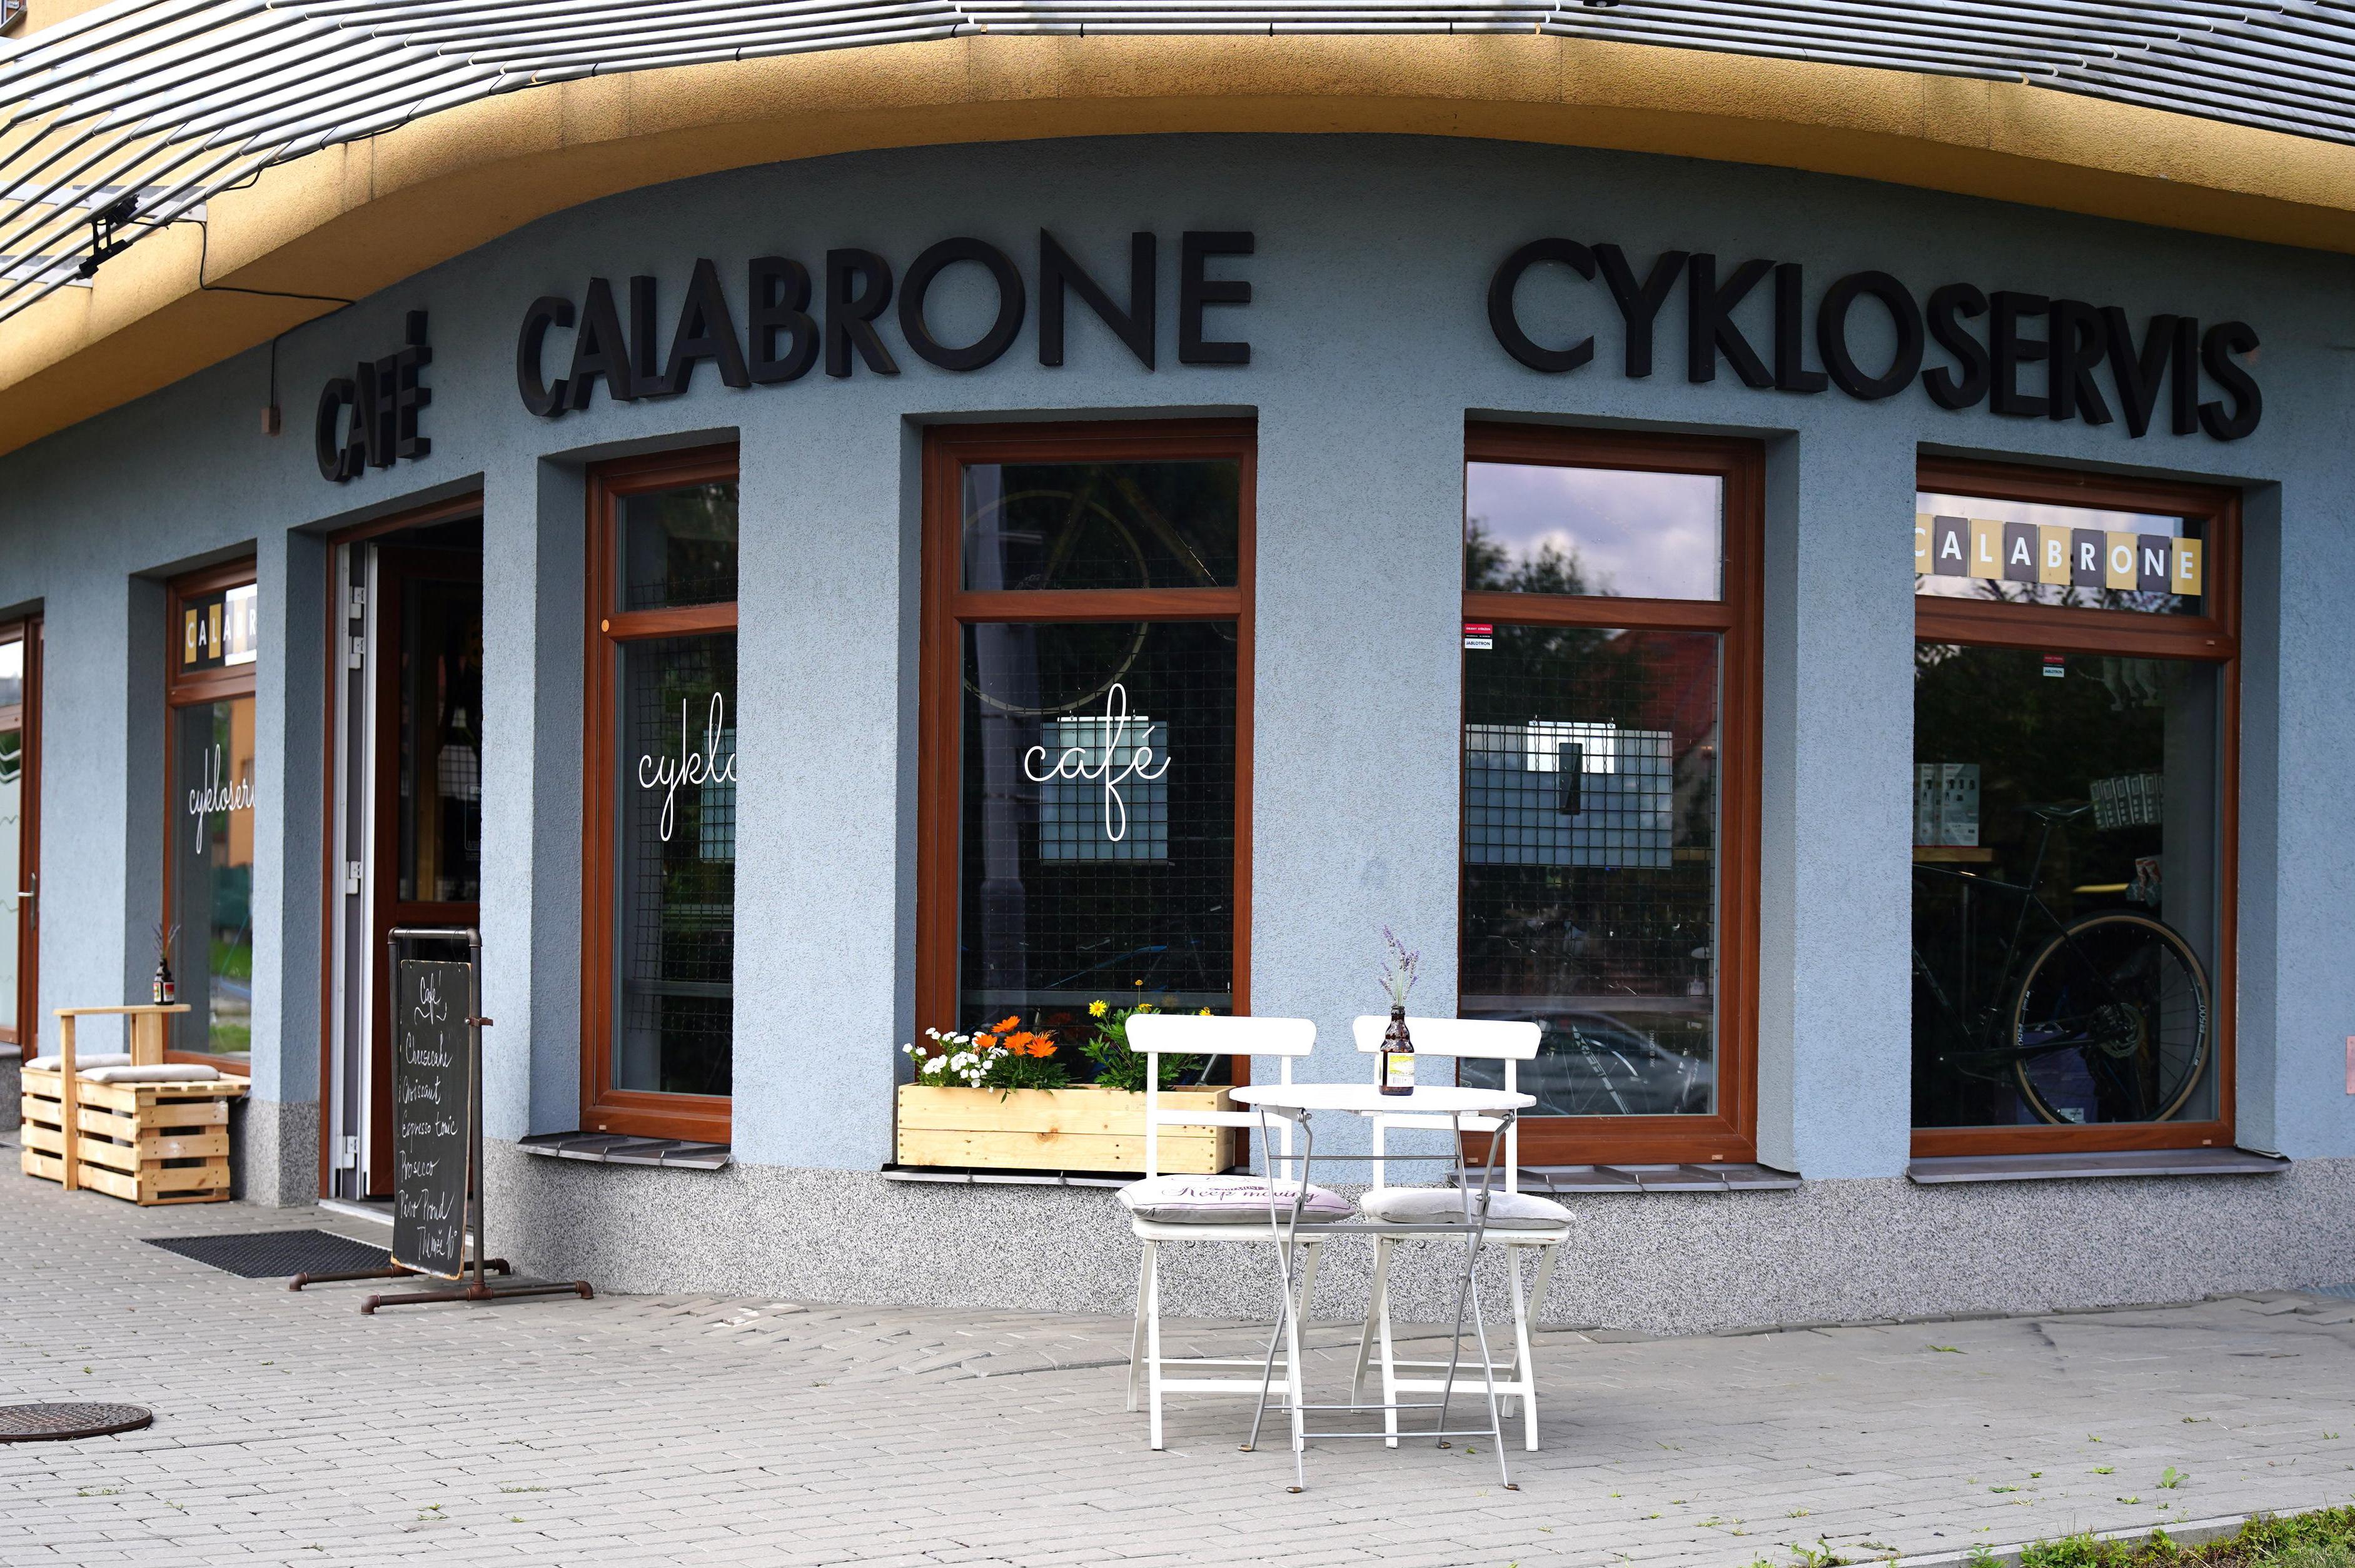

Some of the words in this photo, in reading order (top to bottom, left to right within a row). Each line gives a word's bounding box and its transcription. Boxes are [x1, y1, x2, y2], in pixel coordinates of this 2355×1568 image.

[316, 310, 432, 482] CAFÉ
[517, 226, 1254, 418] CALABRONE
[1487, 238, 2263, 441] CYKLOSERVIS
[1024, 683, 1171, 842] café
[402, 1075, 441, 1105] Croissant
[435, 1111, 458, 1137] tonic
[399, 1150, 440, 1183] Prosecco
[1162, 1187, 1236, 1200] Keep
[1243, 1190, 1319, 1202] movig
